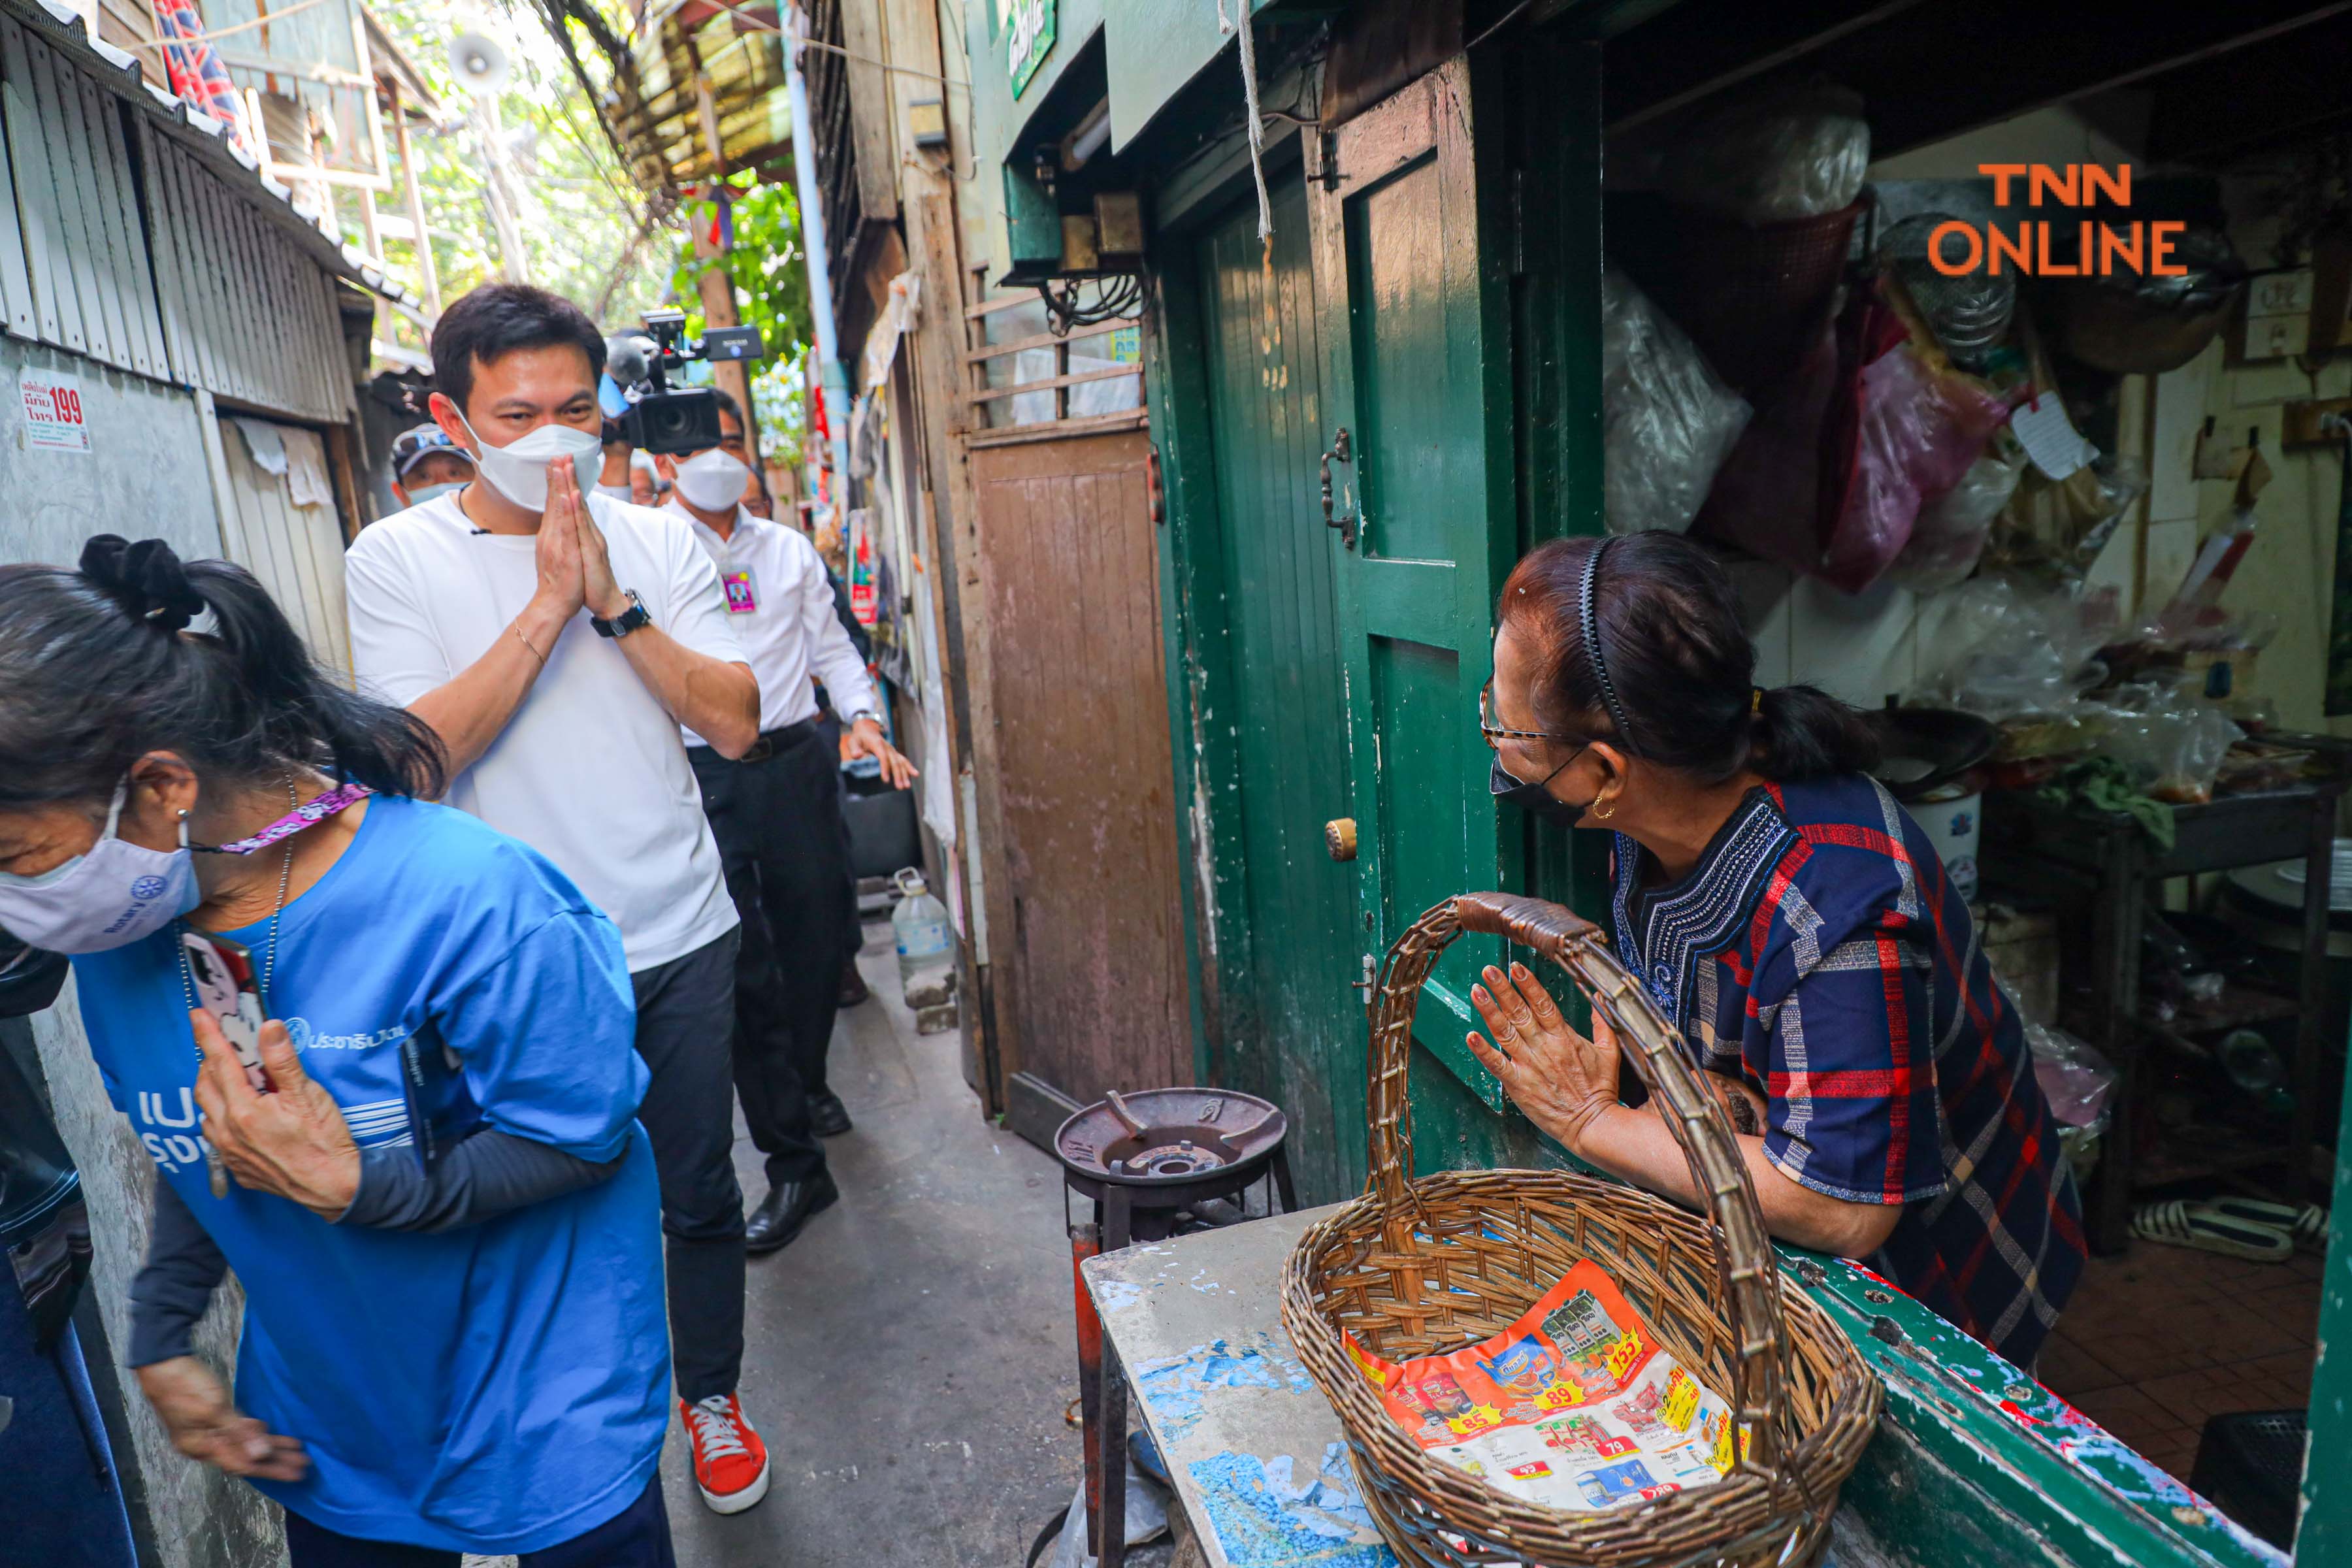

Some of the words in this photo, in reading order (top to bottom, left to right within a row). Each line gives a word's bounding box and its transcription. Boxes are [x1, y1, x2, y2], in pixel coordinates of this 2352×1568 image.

[49, 387, 82, 424] 199
[103, 902, 146, 934] Rotary
[1613, 1341, 1636, 1370] 155
[1684, 1380, 1691, 1390] 46
[1546, 1387, 1573, 1405] 89
[1662, 1394, 1671, 1409] 2
[1690, 1388, 1699, 1400] 40
[1462, 1413, 1488, 1429] 85
[1605, 1441, 1625, 1454] 79
[1712, 1441, 1720, 1458] 2
